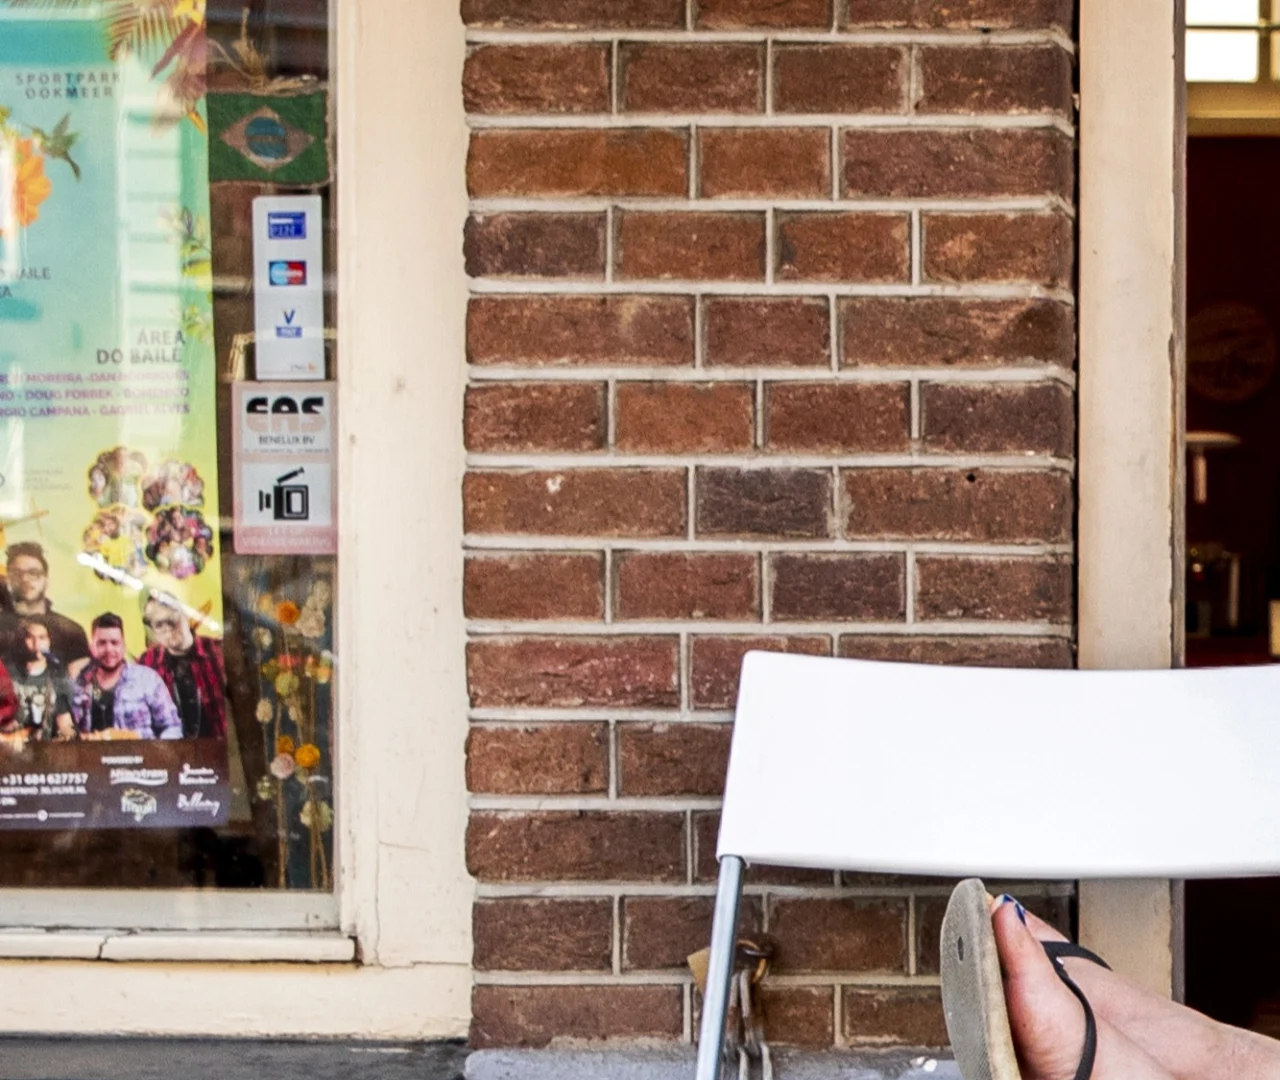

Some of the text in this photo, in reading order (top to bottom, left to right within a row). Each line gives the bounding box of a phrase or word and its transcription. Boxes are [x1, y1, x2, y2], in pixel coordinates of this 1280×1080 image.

[15, 72, 120, 84] SPORTPARK
[25, 87, 113, 99] OOKMEER
[96, 347, 182, 365] DO BAILE
[29, 405, 90, 416] CAMPANA
